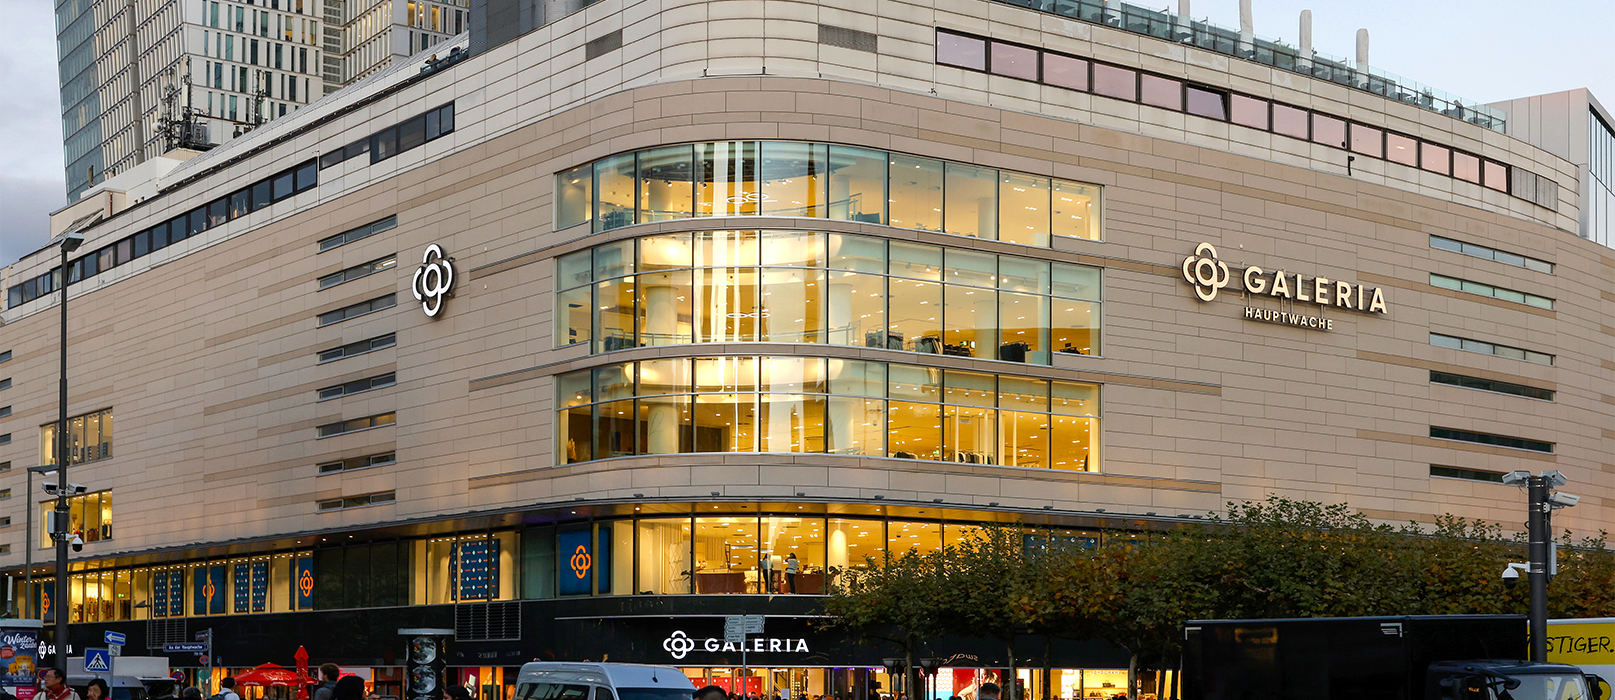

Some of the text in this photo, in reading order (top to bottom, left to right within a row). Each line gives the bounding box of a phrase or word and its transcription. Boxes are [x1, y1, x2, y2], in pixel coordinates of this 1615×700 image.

[1243, 265, 1388, 314] GALERIA
[1245, 307, 1333, 330] HAUPTWACHE
[47, 644, 73, 655] GAIA
[704, 638, 809, 652] GALERIA
[1527, 634, 1615, 654] STIGER.
